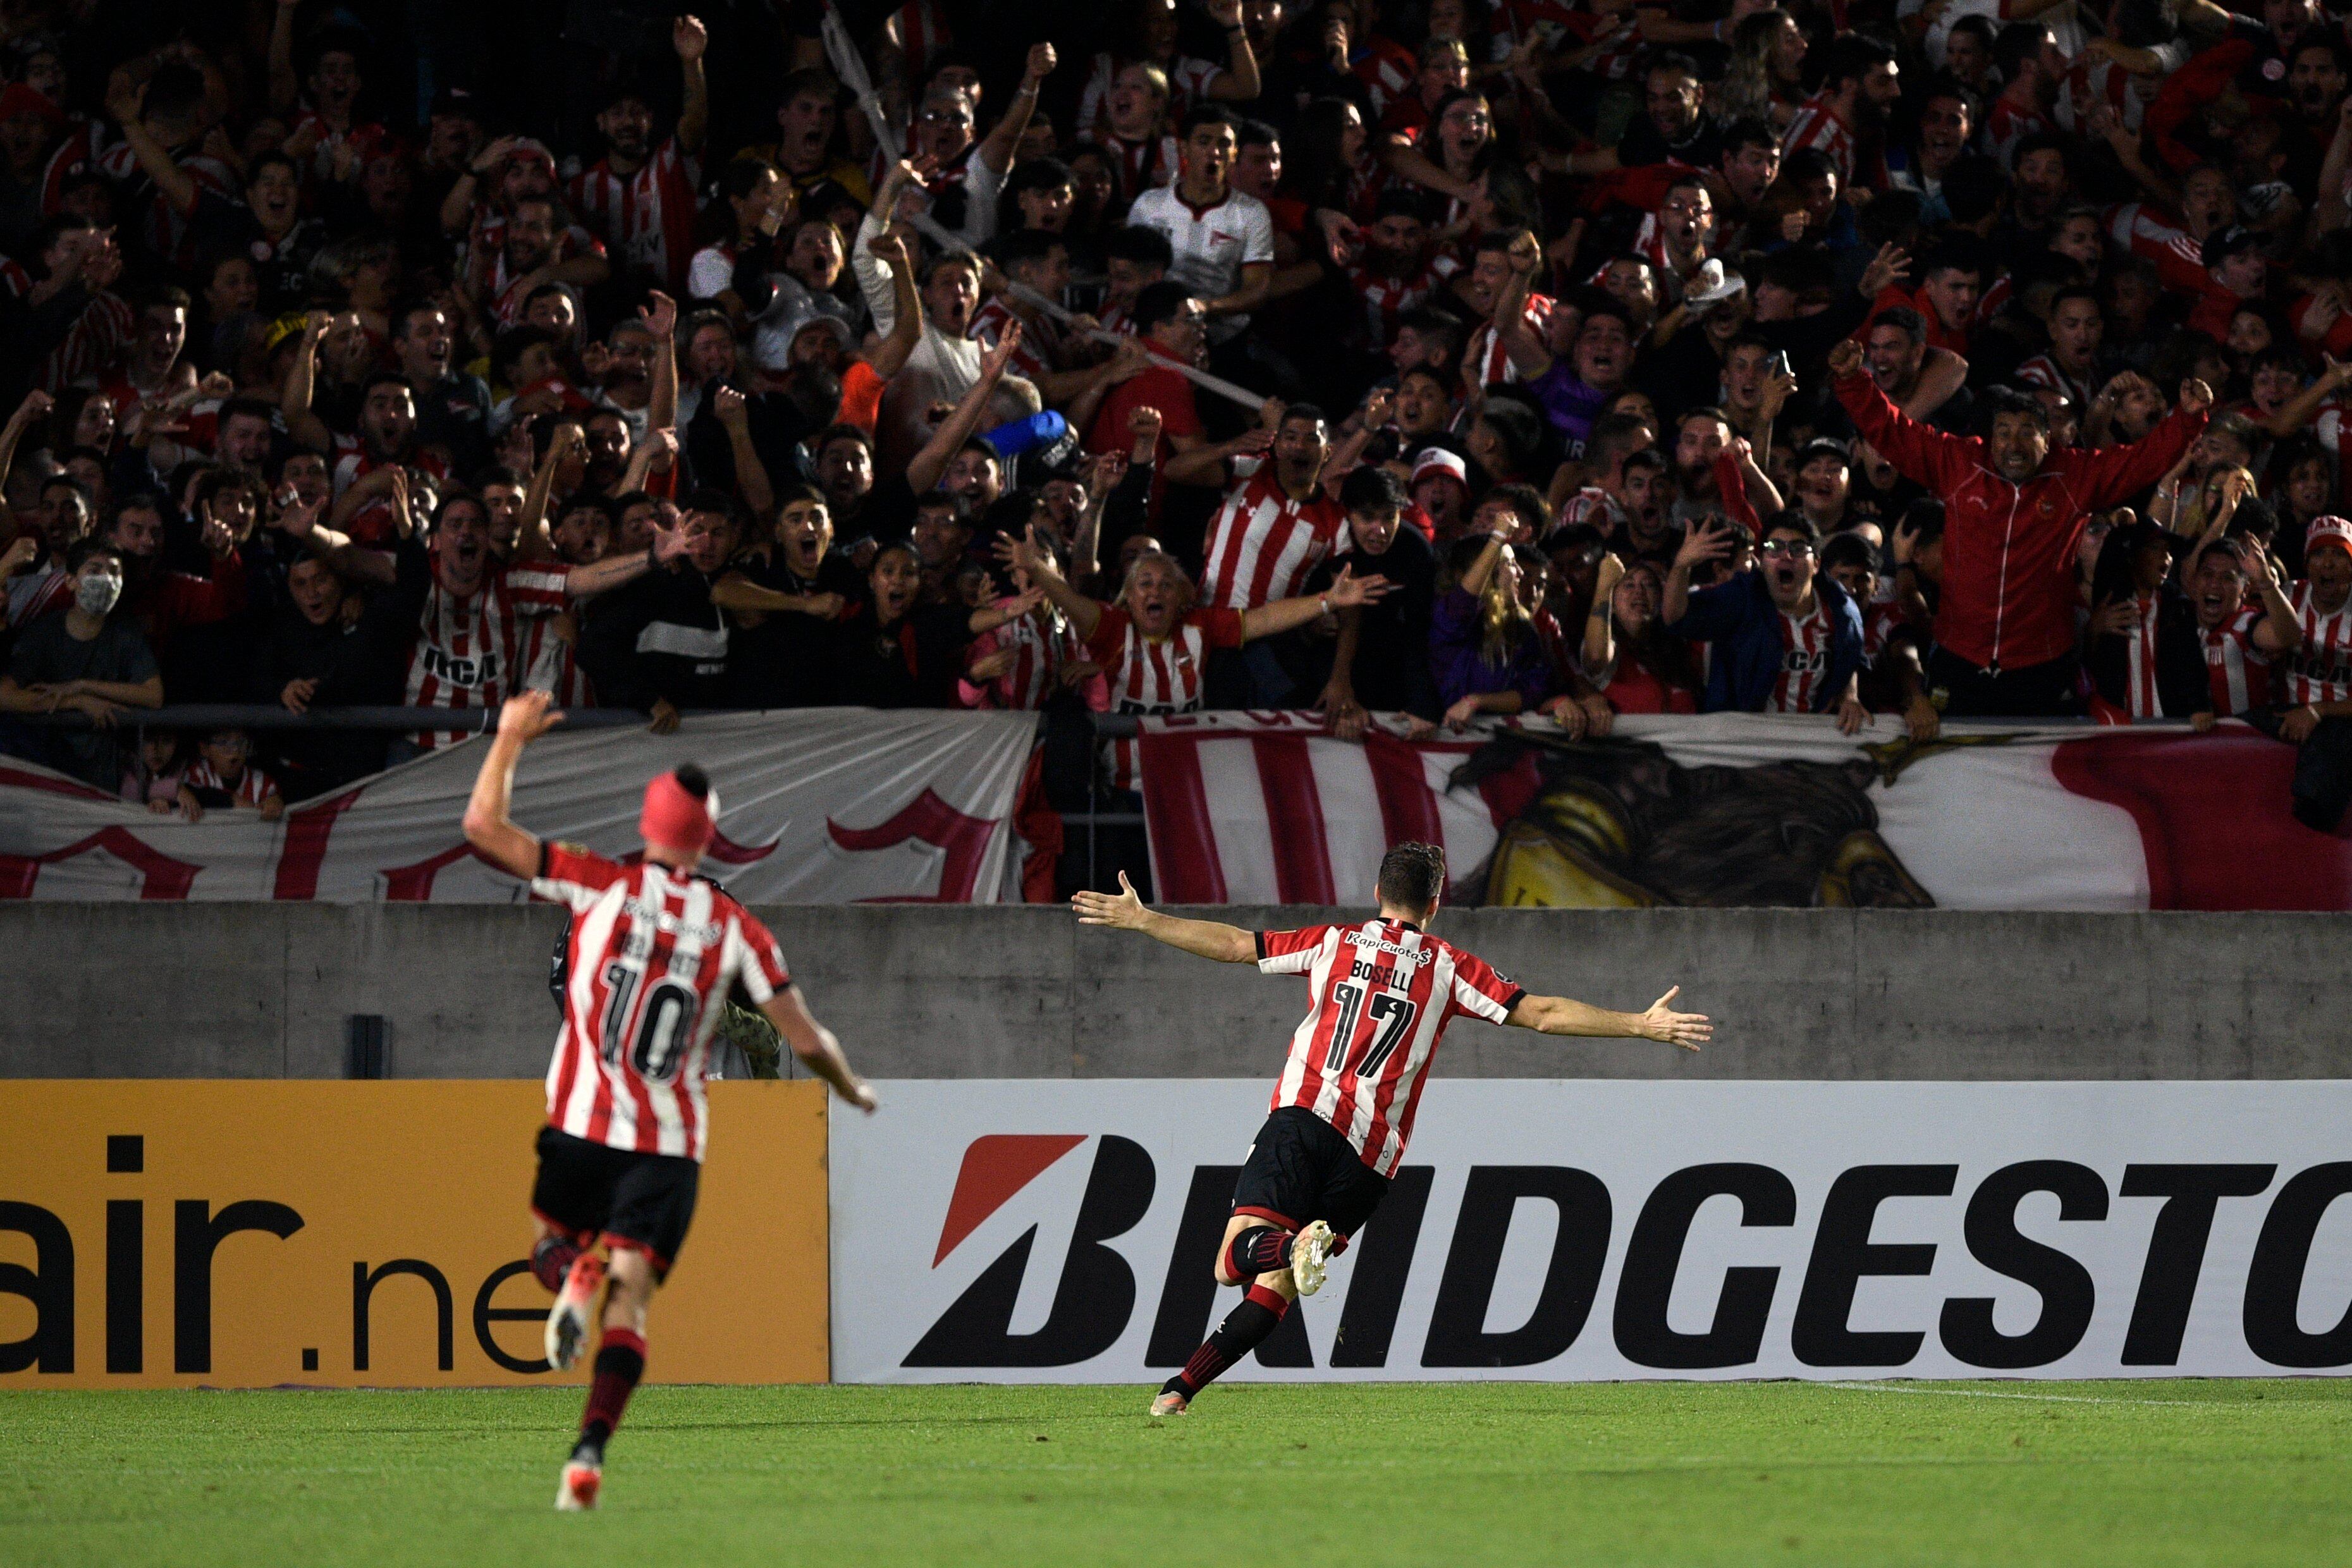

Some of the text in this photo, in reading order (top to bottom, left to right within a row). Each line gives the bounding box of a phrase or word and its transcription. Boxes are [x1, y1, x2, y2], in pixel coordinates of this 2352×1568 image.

[602, 961, 699, 1081] 10
[1351, 959, 1415, 993] BOSELLI
[1325, 981, 1418, 1079] 17
